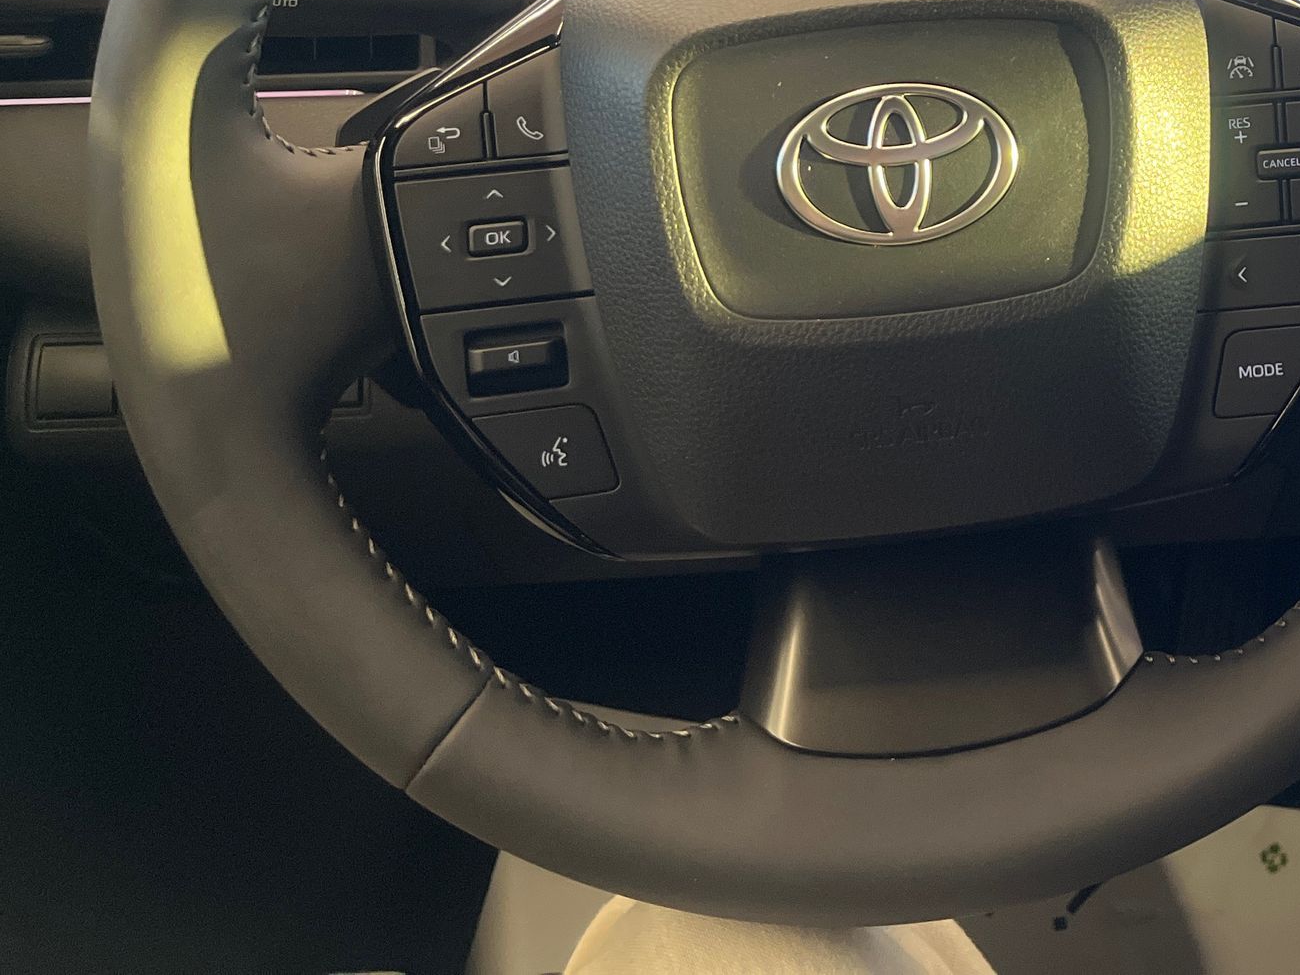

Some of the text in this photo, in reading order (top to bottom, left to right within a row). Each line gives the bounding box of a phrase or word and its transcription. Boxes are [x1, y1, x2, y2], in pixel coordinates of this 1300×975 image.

[1228, 117, 1251, 130] RES
[485, 230, 512, 246] OK
[1237, 362, 1285, 379] MODE
